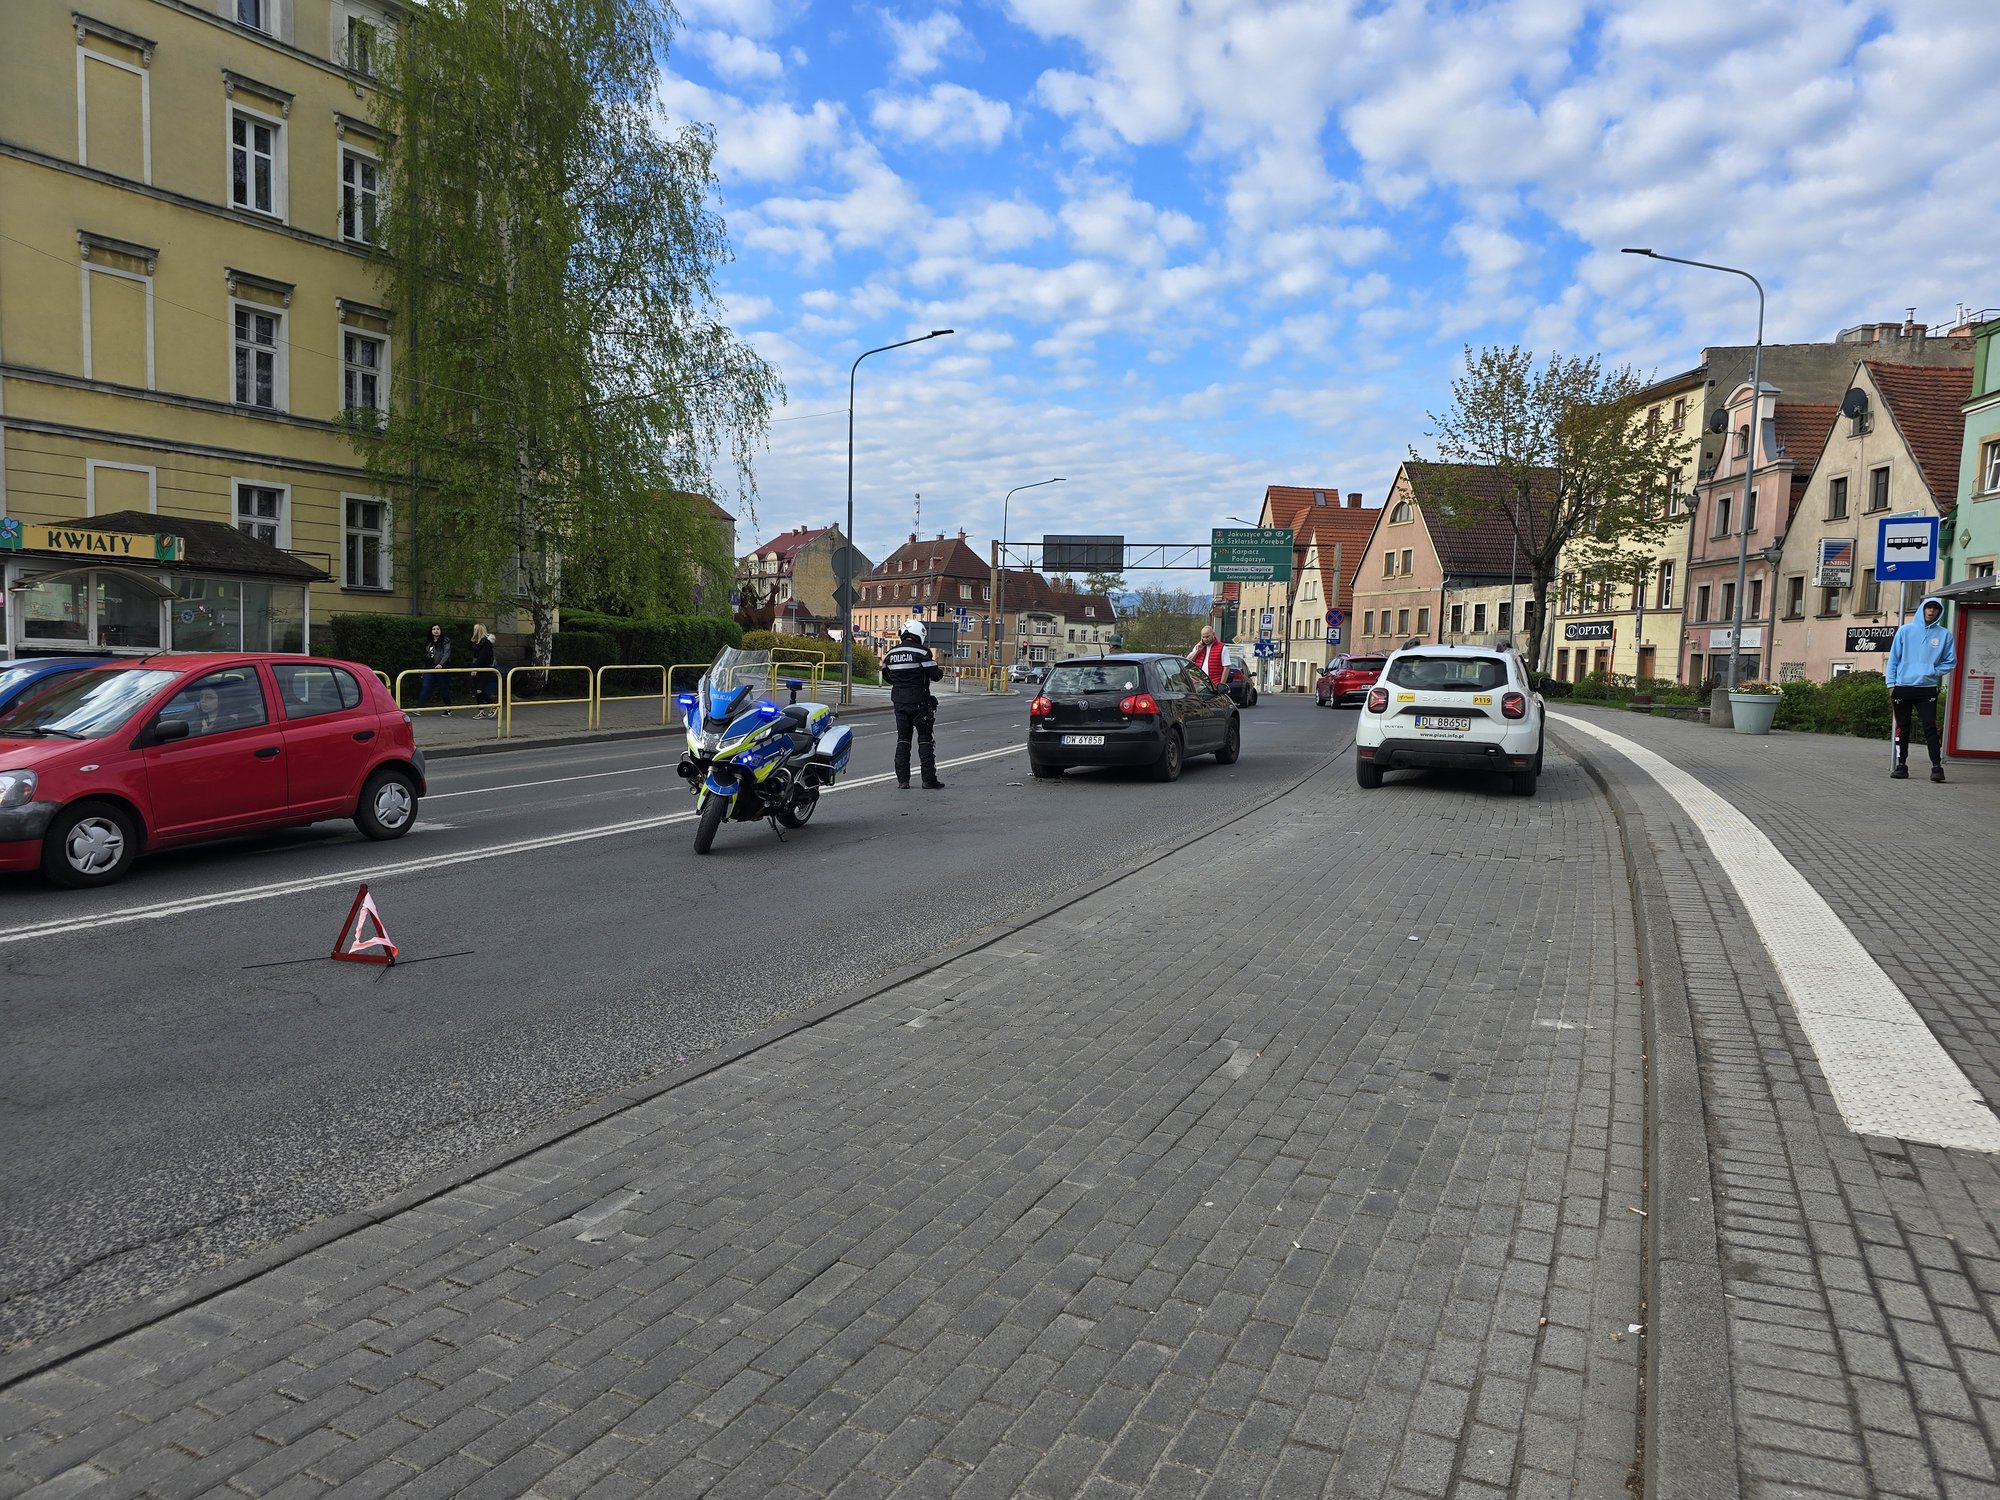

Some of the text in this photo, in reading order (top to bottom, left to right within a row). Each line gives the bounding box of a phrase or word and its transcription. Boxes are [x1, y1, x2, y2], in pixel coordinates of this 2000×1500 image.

[48, 530, 133, 553] KWIATY
[1578, 625, 1610, 636] OPTYK
[1848, 627, 1895, 638] STUDIO FRYZUR
[1855, 637, 1877, 651] Diva
[890, 653, 913, 663] POLICJA
[1421, 717, 1467, 728] DL 8865G
[1066, 736, 1076, 744] DW
